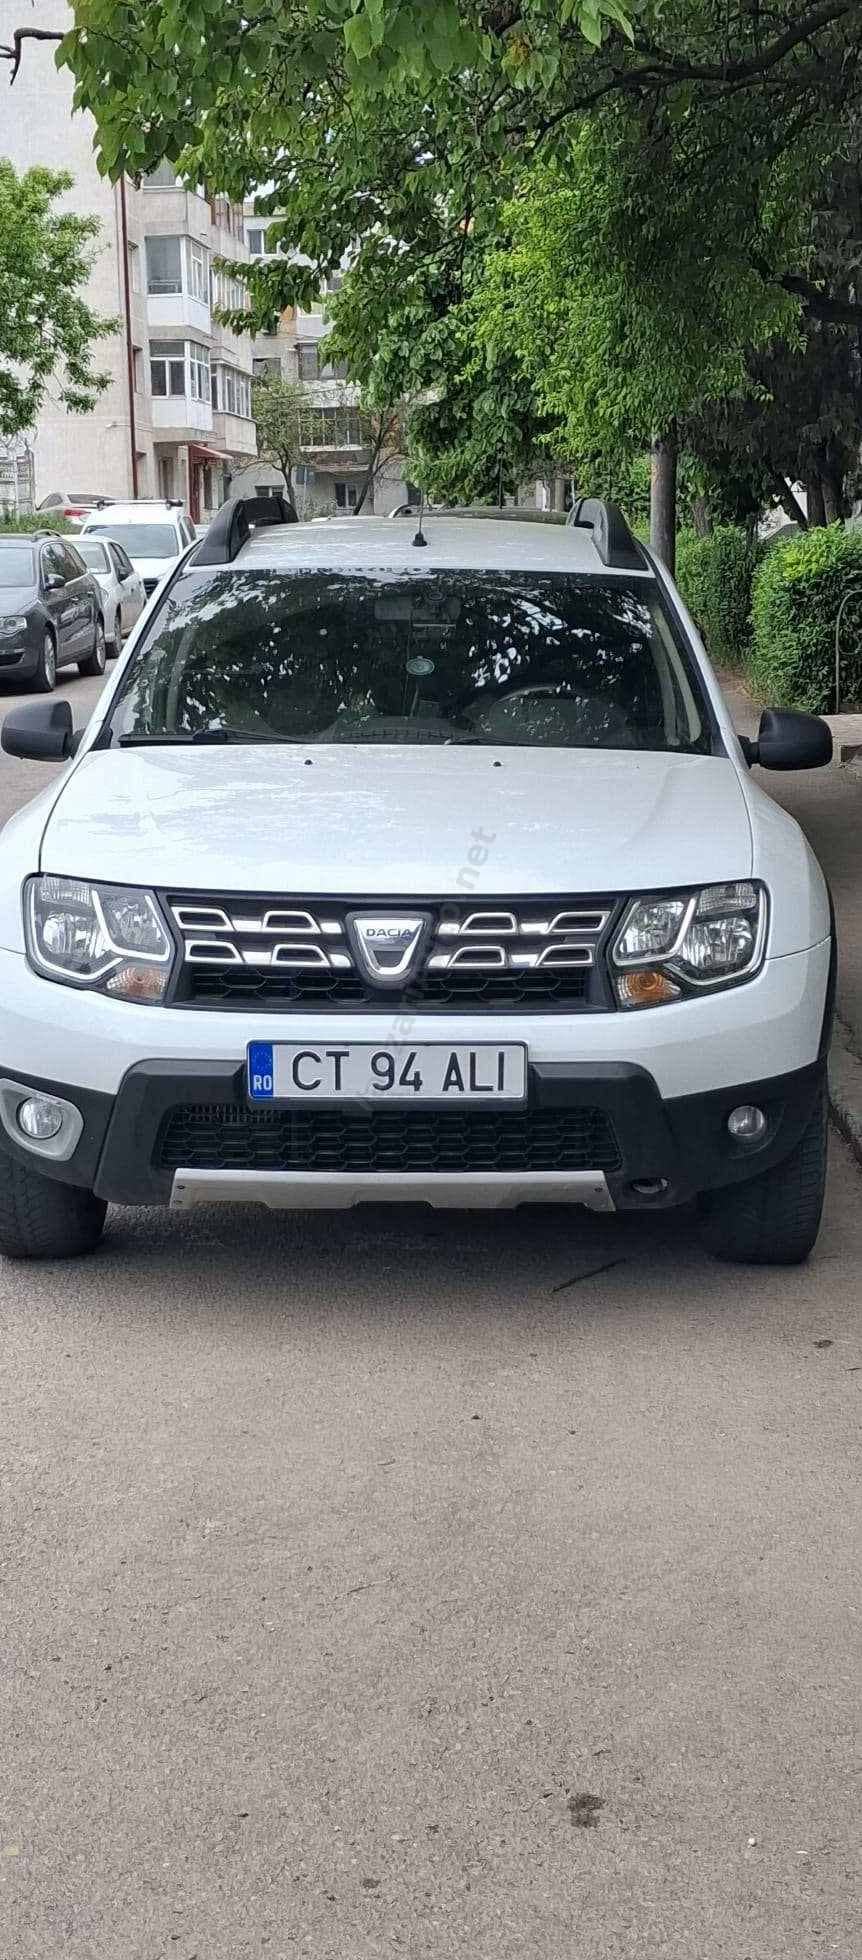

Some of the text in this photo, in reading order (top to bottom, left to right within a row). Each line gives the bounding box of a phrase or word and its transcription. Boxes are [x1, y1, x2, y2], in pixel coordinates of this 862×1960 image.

[366, 928, 411, 938] DACIA
[292, 1051, 505, 1092] CT 94 ALI
[253, 1074, 272, 1090] RO
